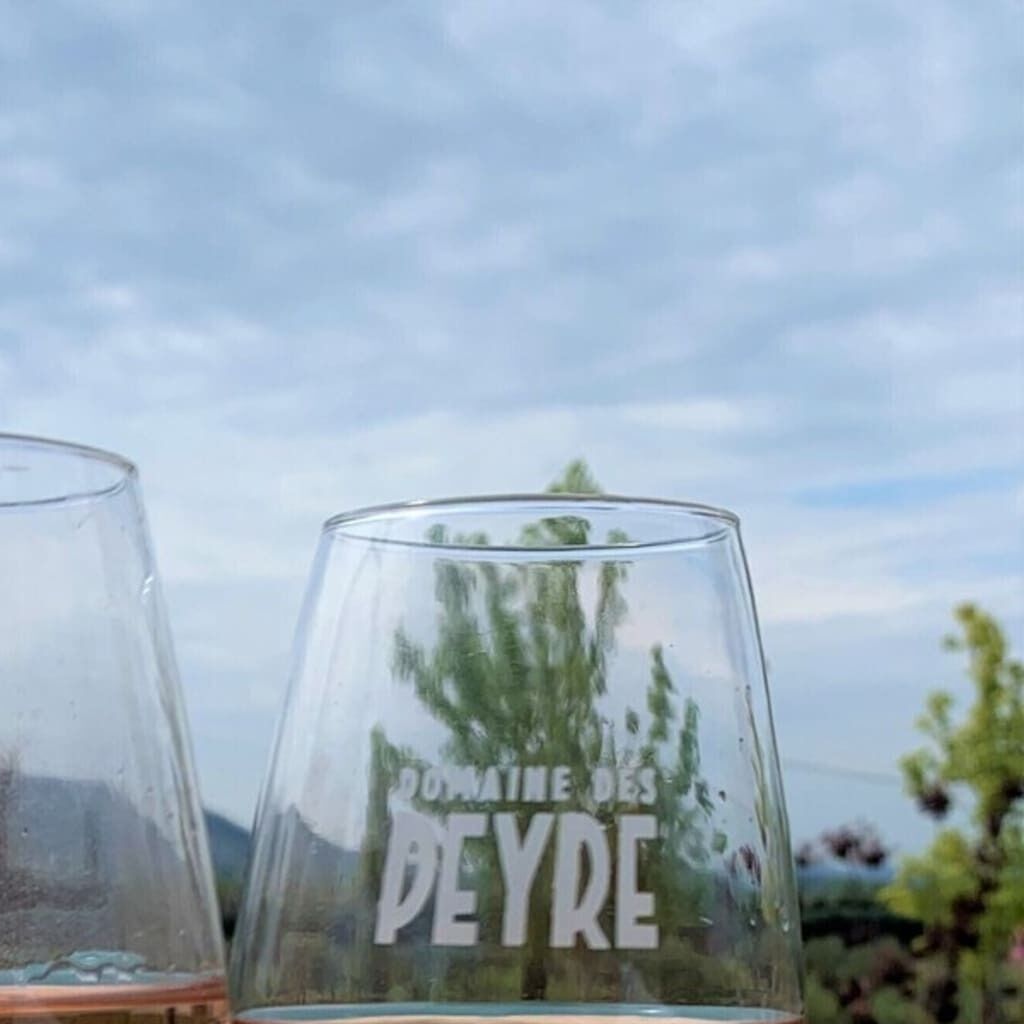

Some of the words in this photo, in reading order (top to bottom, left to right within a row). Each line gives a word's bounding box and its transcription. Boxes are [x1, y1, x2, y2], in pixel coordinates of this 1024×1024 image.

[396, 766, 572, 802] DOMAINE
[591, 767, 657, 804] DES
[374, 811, 658, 950] PEYRE
